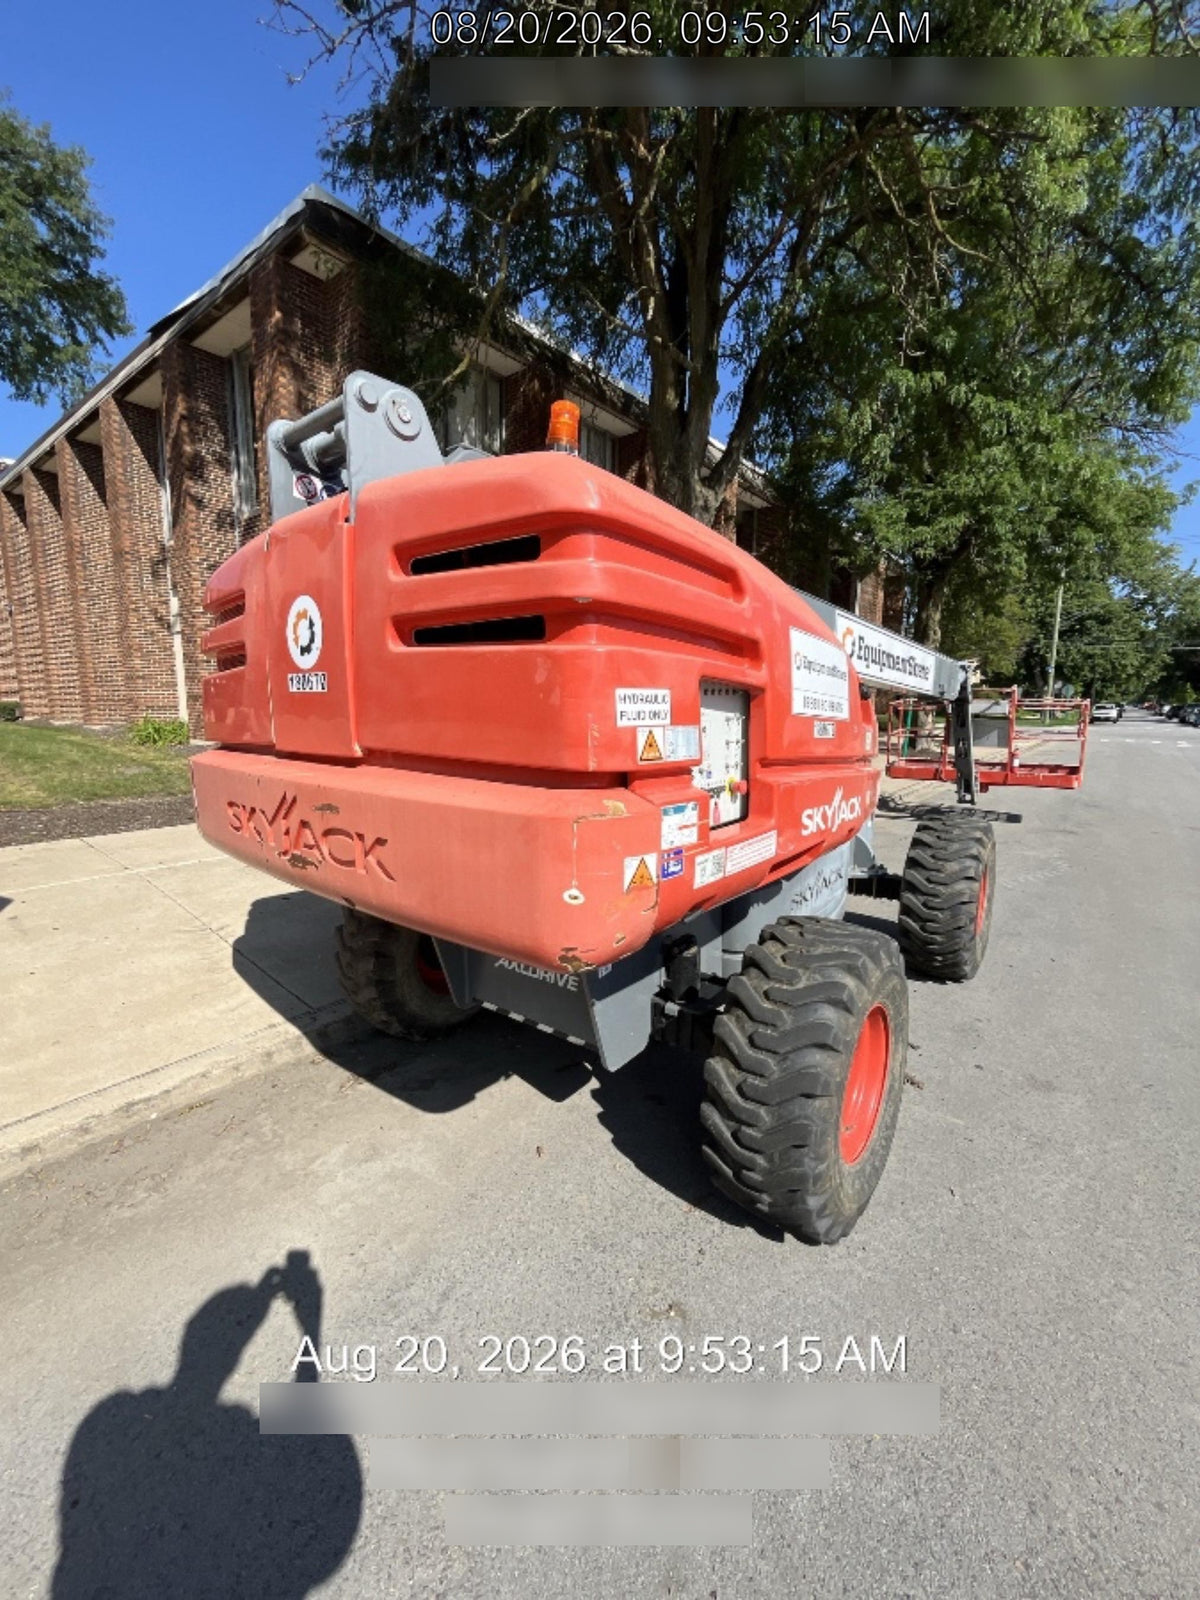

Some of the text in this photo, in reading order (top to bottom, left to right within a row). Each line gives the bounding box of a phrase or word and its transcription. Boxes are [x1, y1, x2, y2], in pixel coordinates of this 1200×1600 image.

[618, 692, 669, 705] HYDRAULIC
[620, 708, 669, 722] FLUID ONLY
[226, 790, 397, 882] SKYJACK
